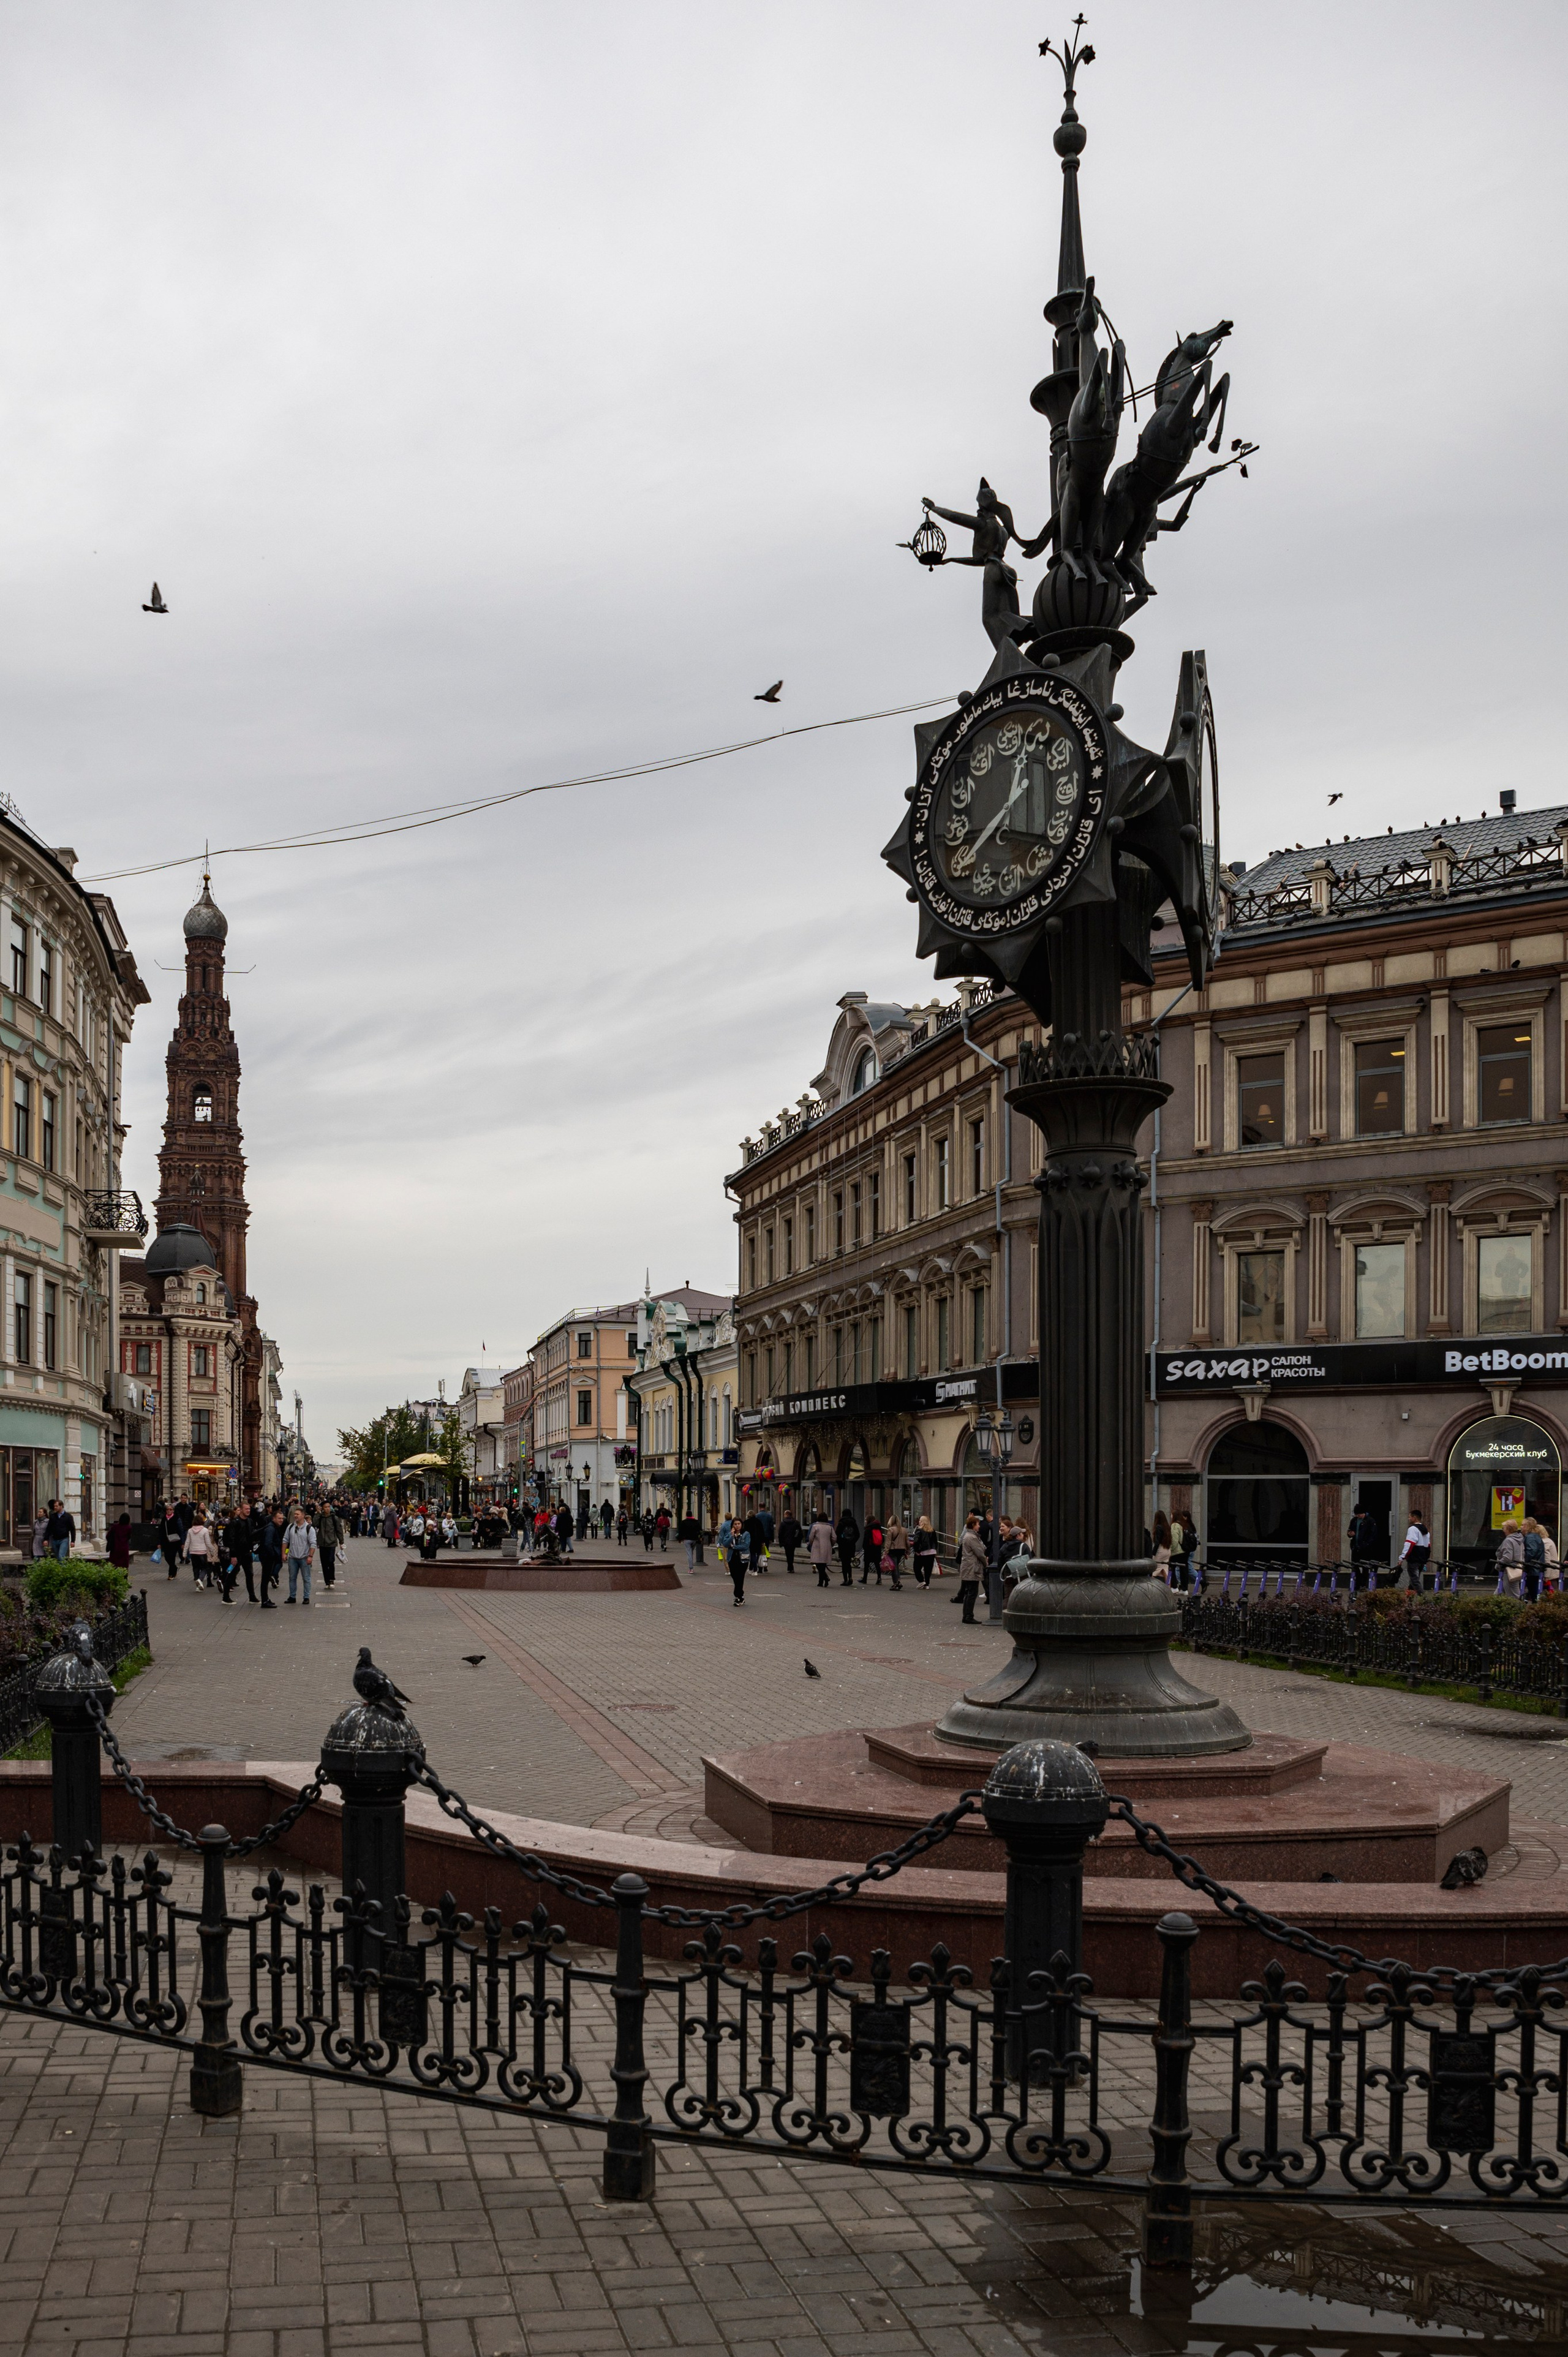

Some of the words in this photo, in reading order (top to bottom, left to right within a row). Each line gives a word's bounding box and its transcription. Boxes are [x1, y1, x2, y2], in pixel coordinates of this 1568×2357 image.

[1271, 1356, 1311, 1366] САЛОН
[1445, 1349, 1568, 1372] BetBoom
[1271, 1367, 1325, 1378] КРАСОТЫ
[945, 1379, 977, 1397] МАГНИТ
[790, 1395, 846, 1414] КОМПЛЕКС
[1466, 1450, 1525, 1460] Букмекерский
[1527, 1449, 1547, 1458] клуб
